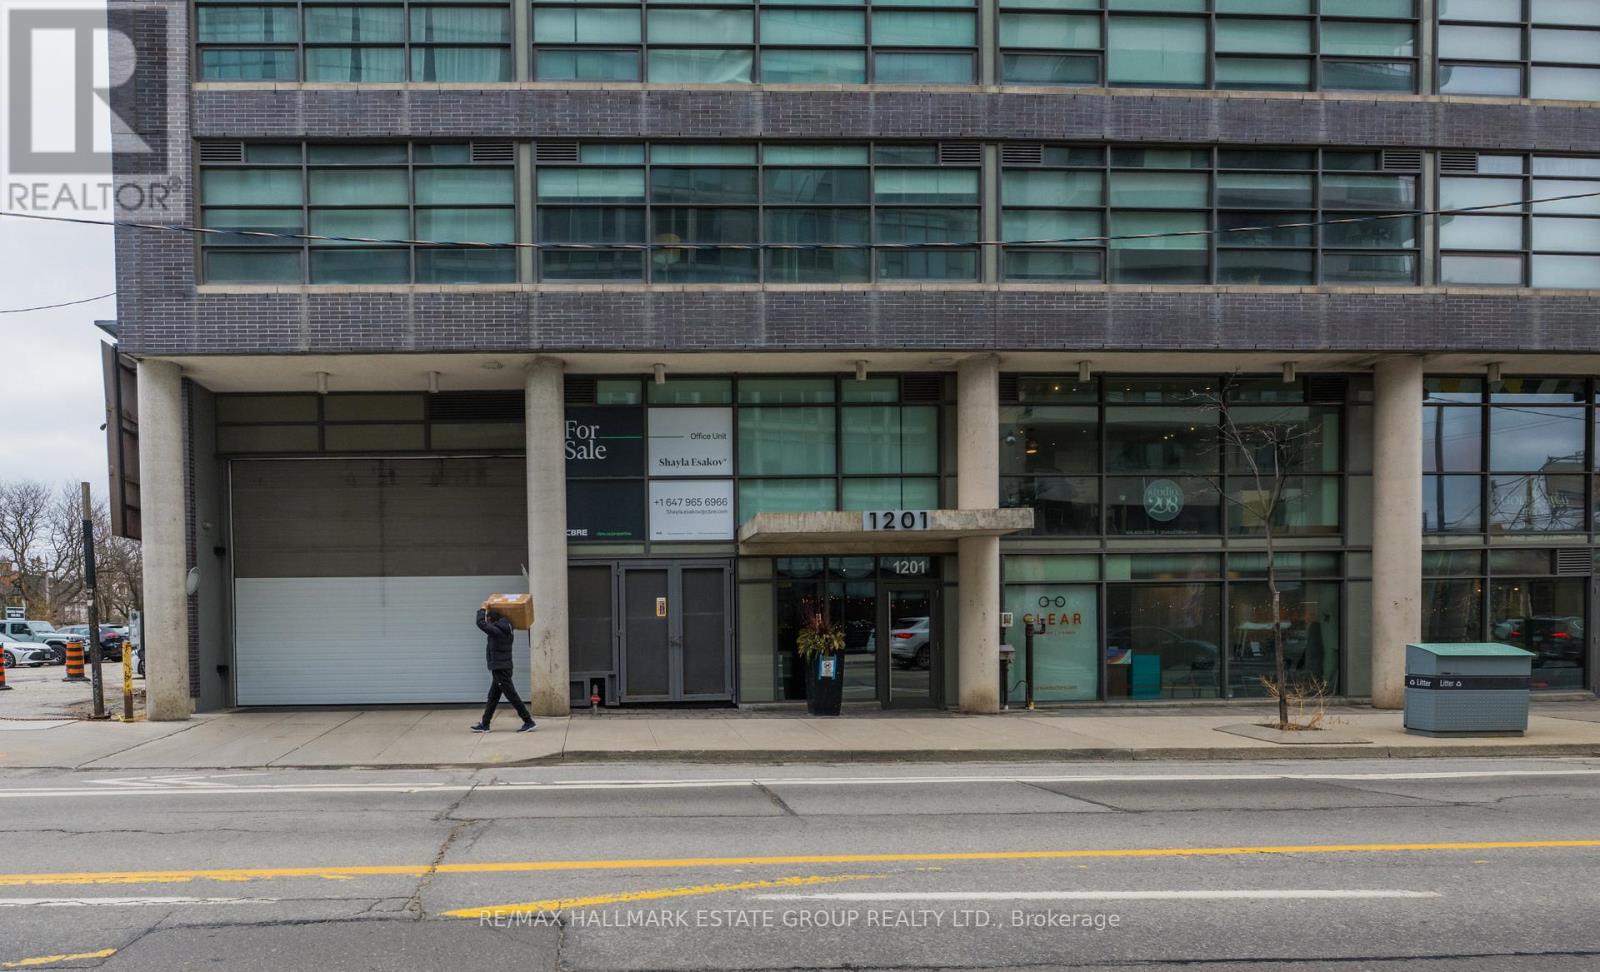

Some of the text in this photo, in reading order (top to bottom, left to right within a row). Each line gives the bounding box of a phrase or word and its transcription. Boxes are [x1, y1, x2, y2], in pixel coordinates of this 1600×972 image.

[565, 420, 600, 439] For
[690, 432, 727, 440] Office Unit
[565, 439, 607, 460] Sale
[658, 458, 690, 469] Shayla
[654, 497, 728, 506] +1 647 965 6966
[1148, 496, 1179, 514] 208
[869, 511, 928, 529] 1201
[893, 560, 926, 574] 1201
[1416, 678, 1432, 687] Litter
